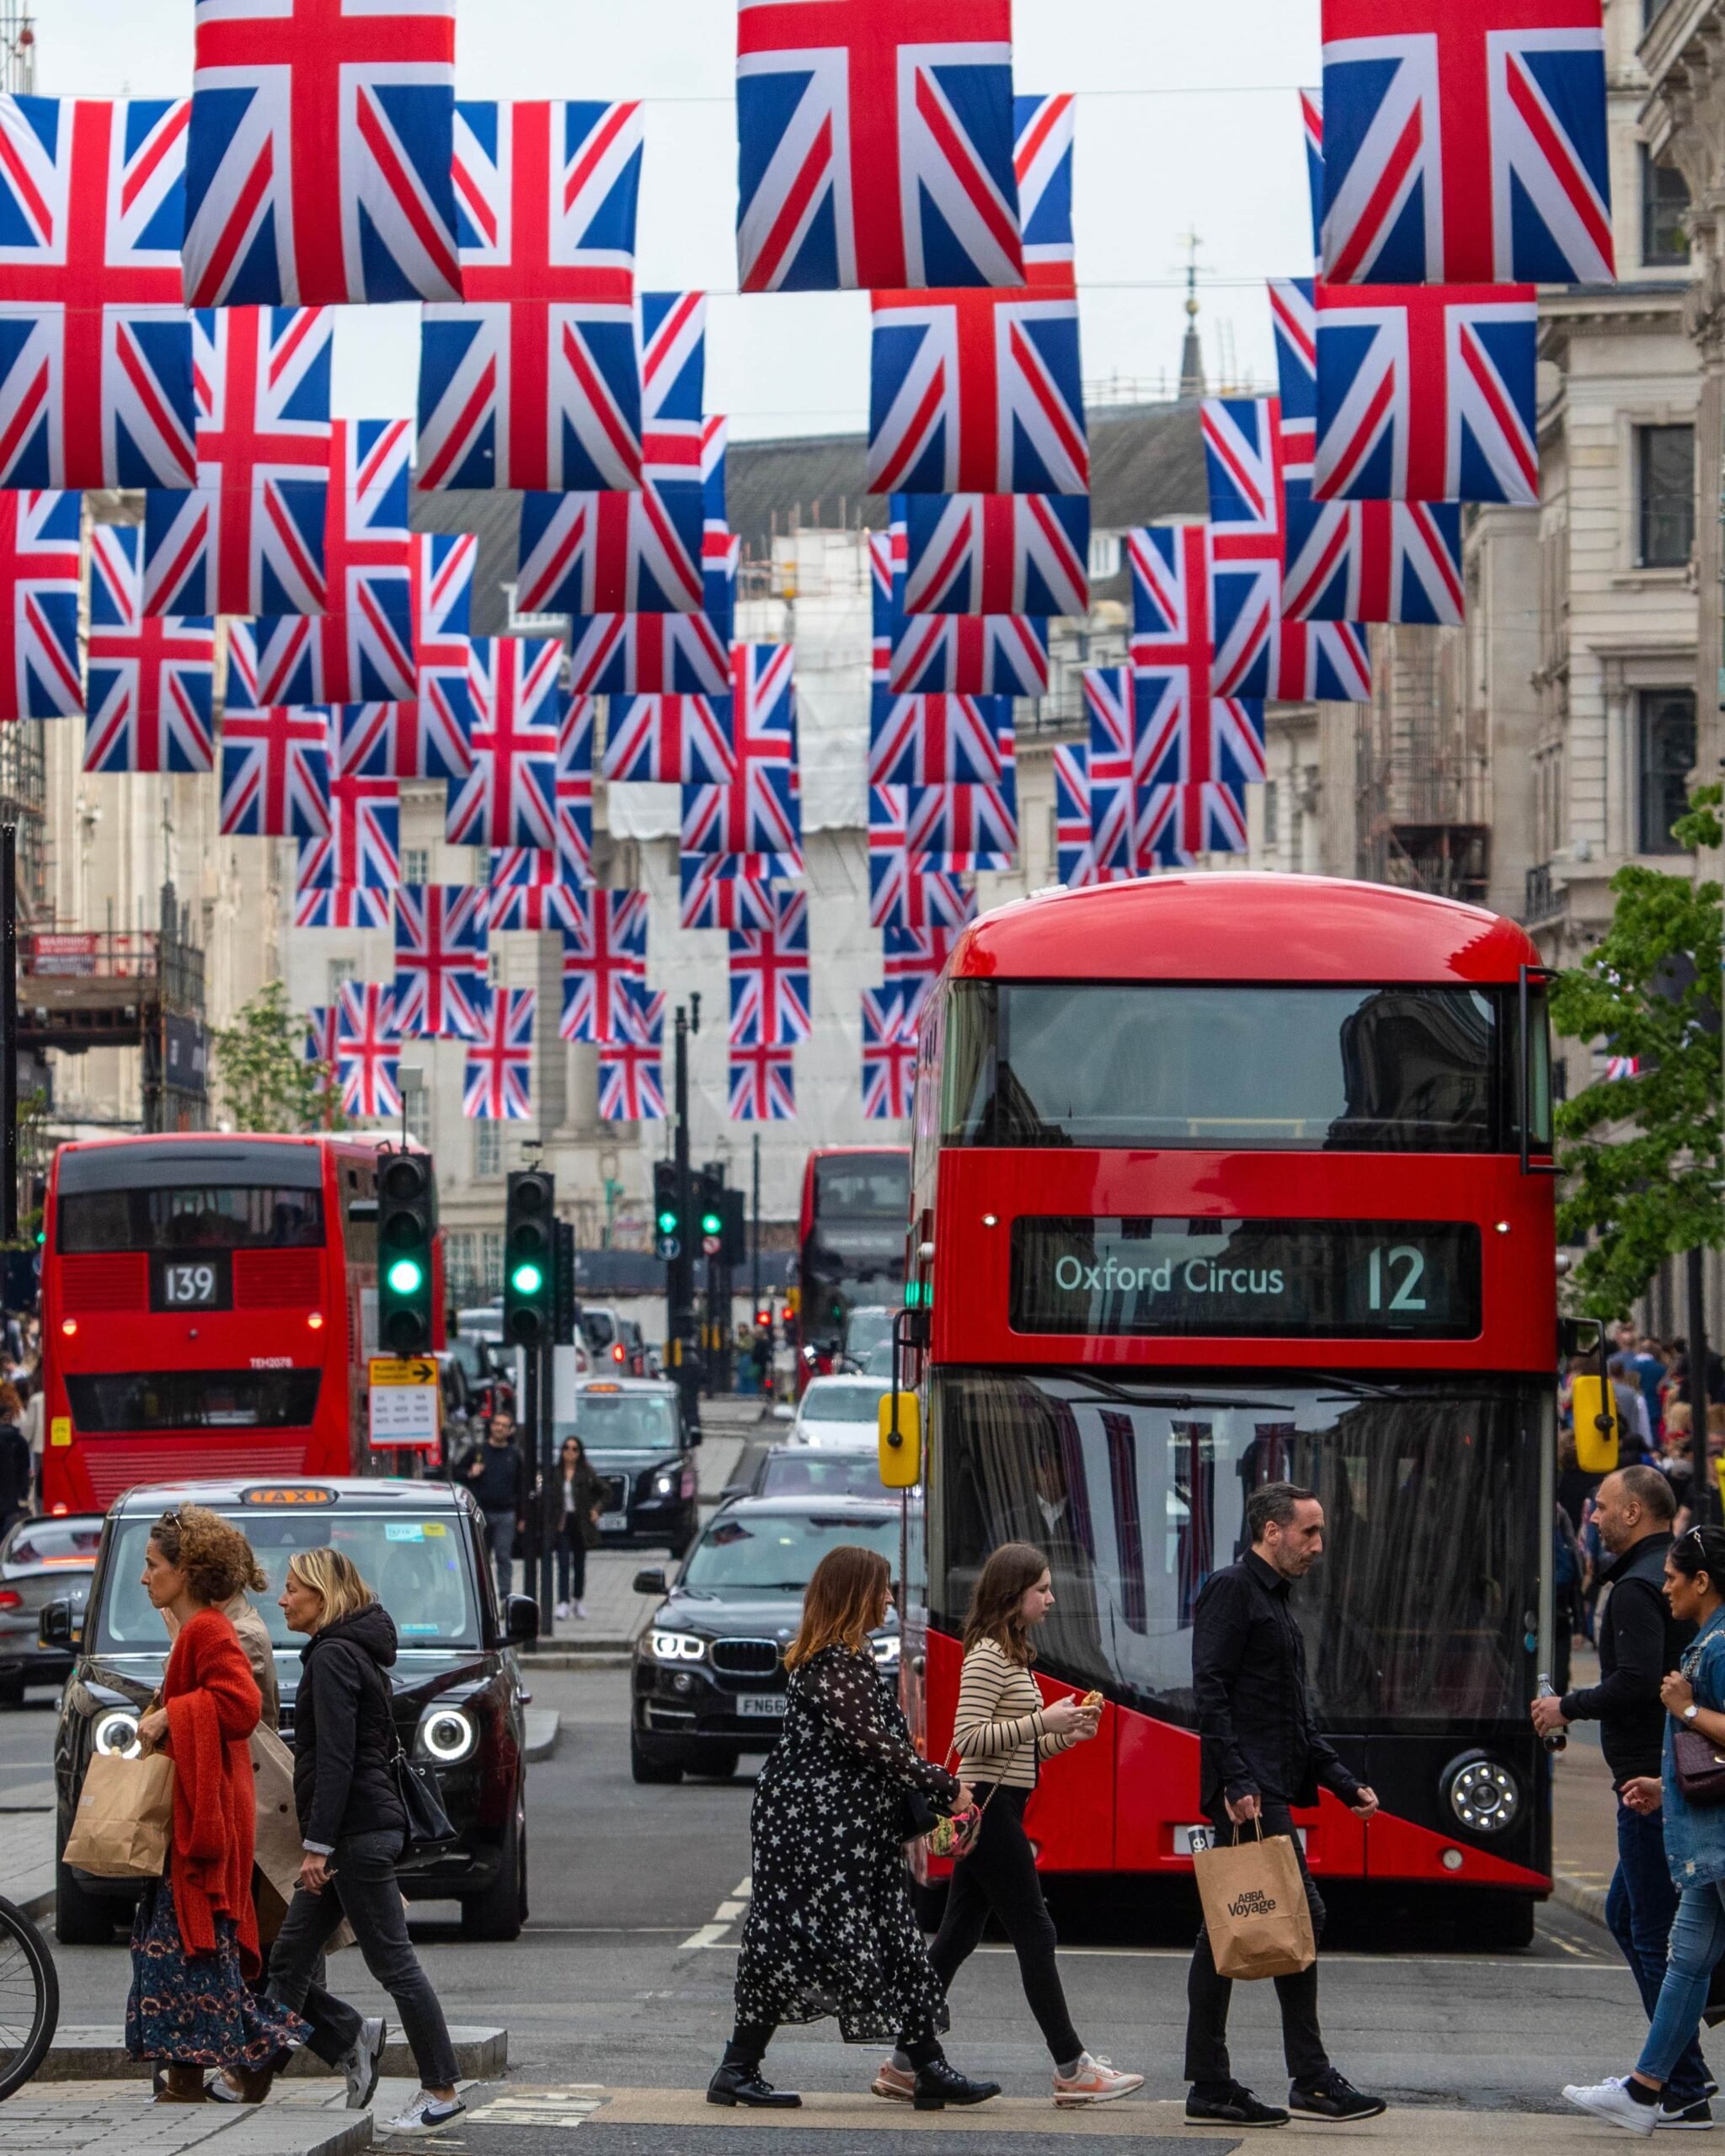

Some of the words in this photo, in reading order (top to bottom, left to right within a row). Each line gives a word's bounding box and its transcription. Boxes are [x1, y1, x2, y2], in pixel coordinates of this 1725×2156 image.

[168, 1267, 213, 1300] 139
[1055, 1256, 1171, 1291] Oxford
[1184, 1258, 1284, 1294] Circus
[1370, 1246, 1426, 1309] 12
[256, 1489, 322, 1503] TAXI
[744, 1699, 783, 1713] FN66
[1238, 1890, 1265, 1904] ABBA
[1227, 1899, 1276, 1918] Voyage
